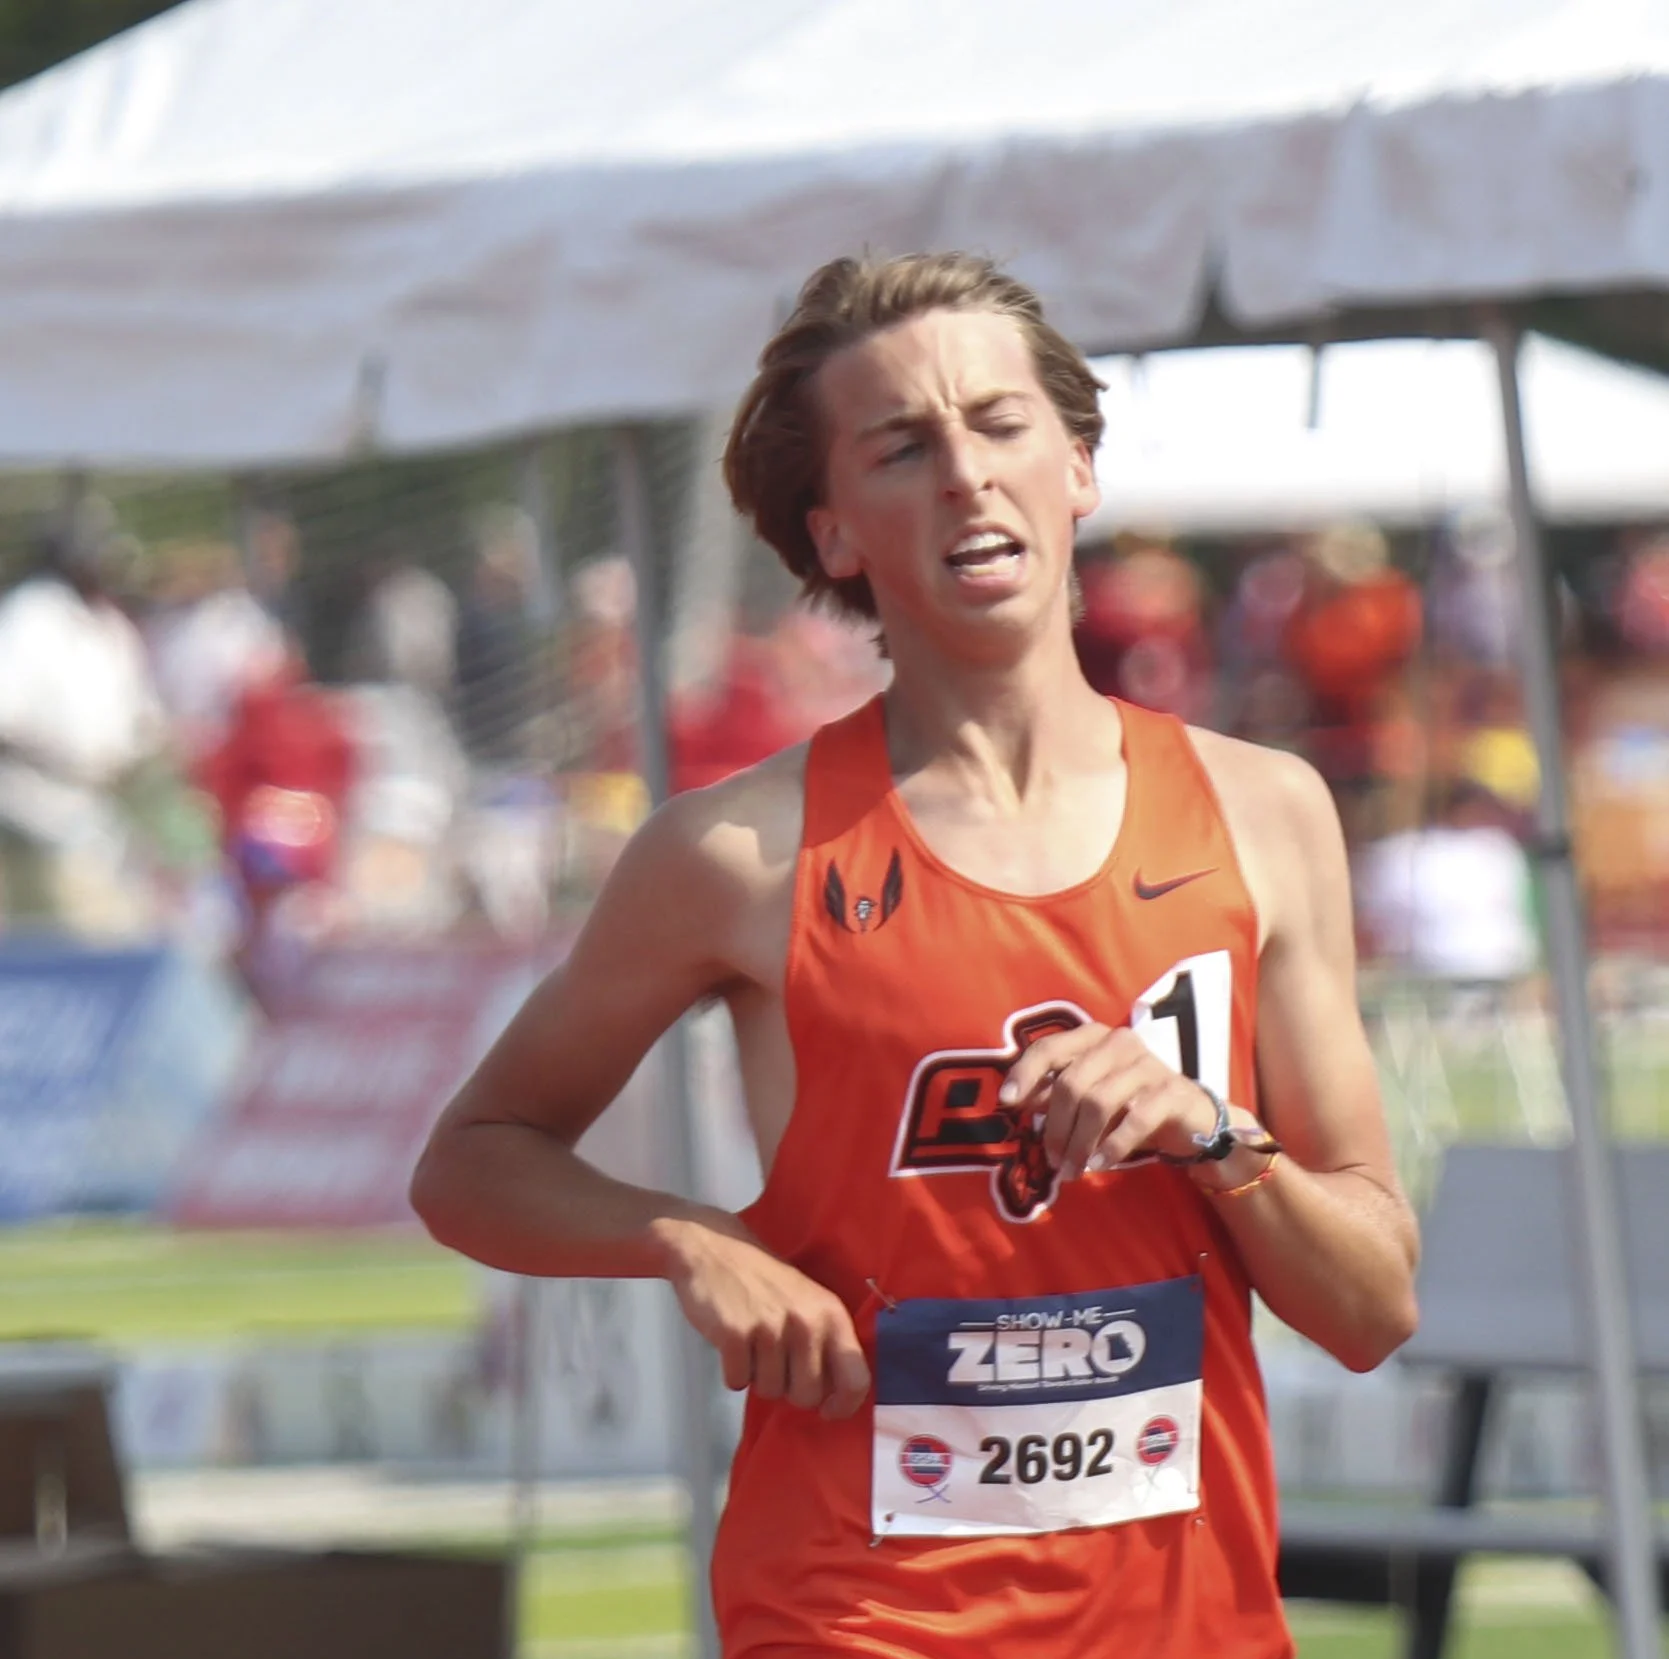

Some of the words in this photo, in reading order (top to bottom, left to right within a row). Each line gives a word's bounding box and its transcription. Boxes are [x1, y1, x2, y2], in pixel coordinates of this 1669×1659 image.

[1151, 970, 1199, 1079] 1
[996, 1306, 1103, 1330] SHOW-ME
[948, 1320, 1145, 1383] ZERO
[979, 1429, 1114, 1485] 2692
